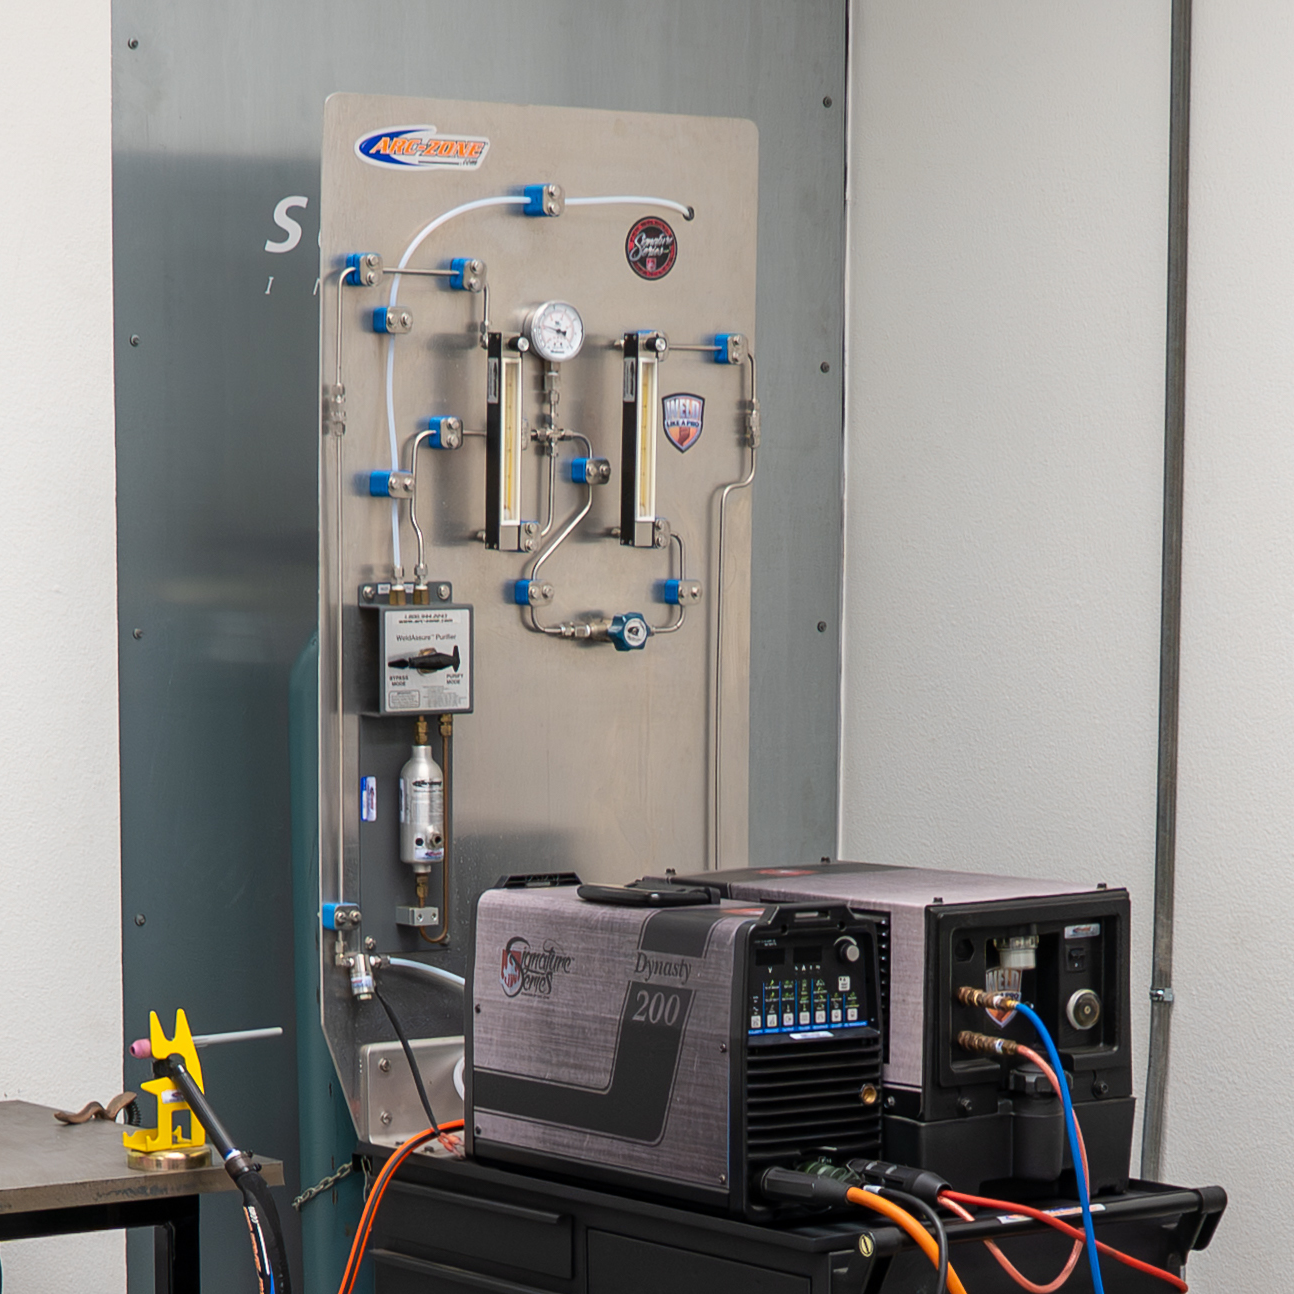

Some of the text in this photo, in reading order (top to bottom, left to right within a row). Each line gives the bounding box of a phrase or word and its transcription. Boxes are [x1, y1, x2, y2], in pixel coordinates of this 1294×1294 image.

[369, 137, 486, 158] ARC-ZONE
[264, 195, 322, 253] S
[666, 398, 700, 421] WELD
[634, 952, 692, 986] Dynasty
[987, 968, 1021, 992] WELD
[632, 989, 681, 1026] 200
